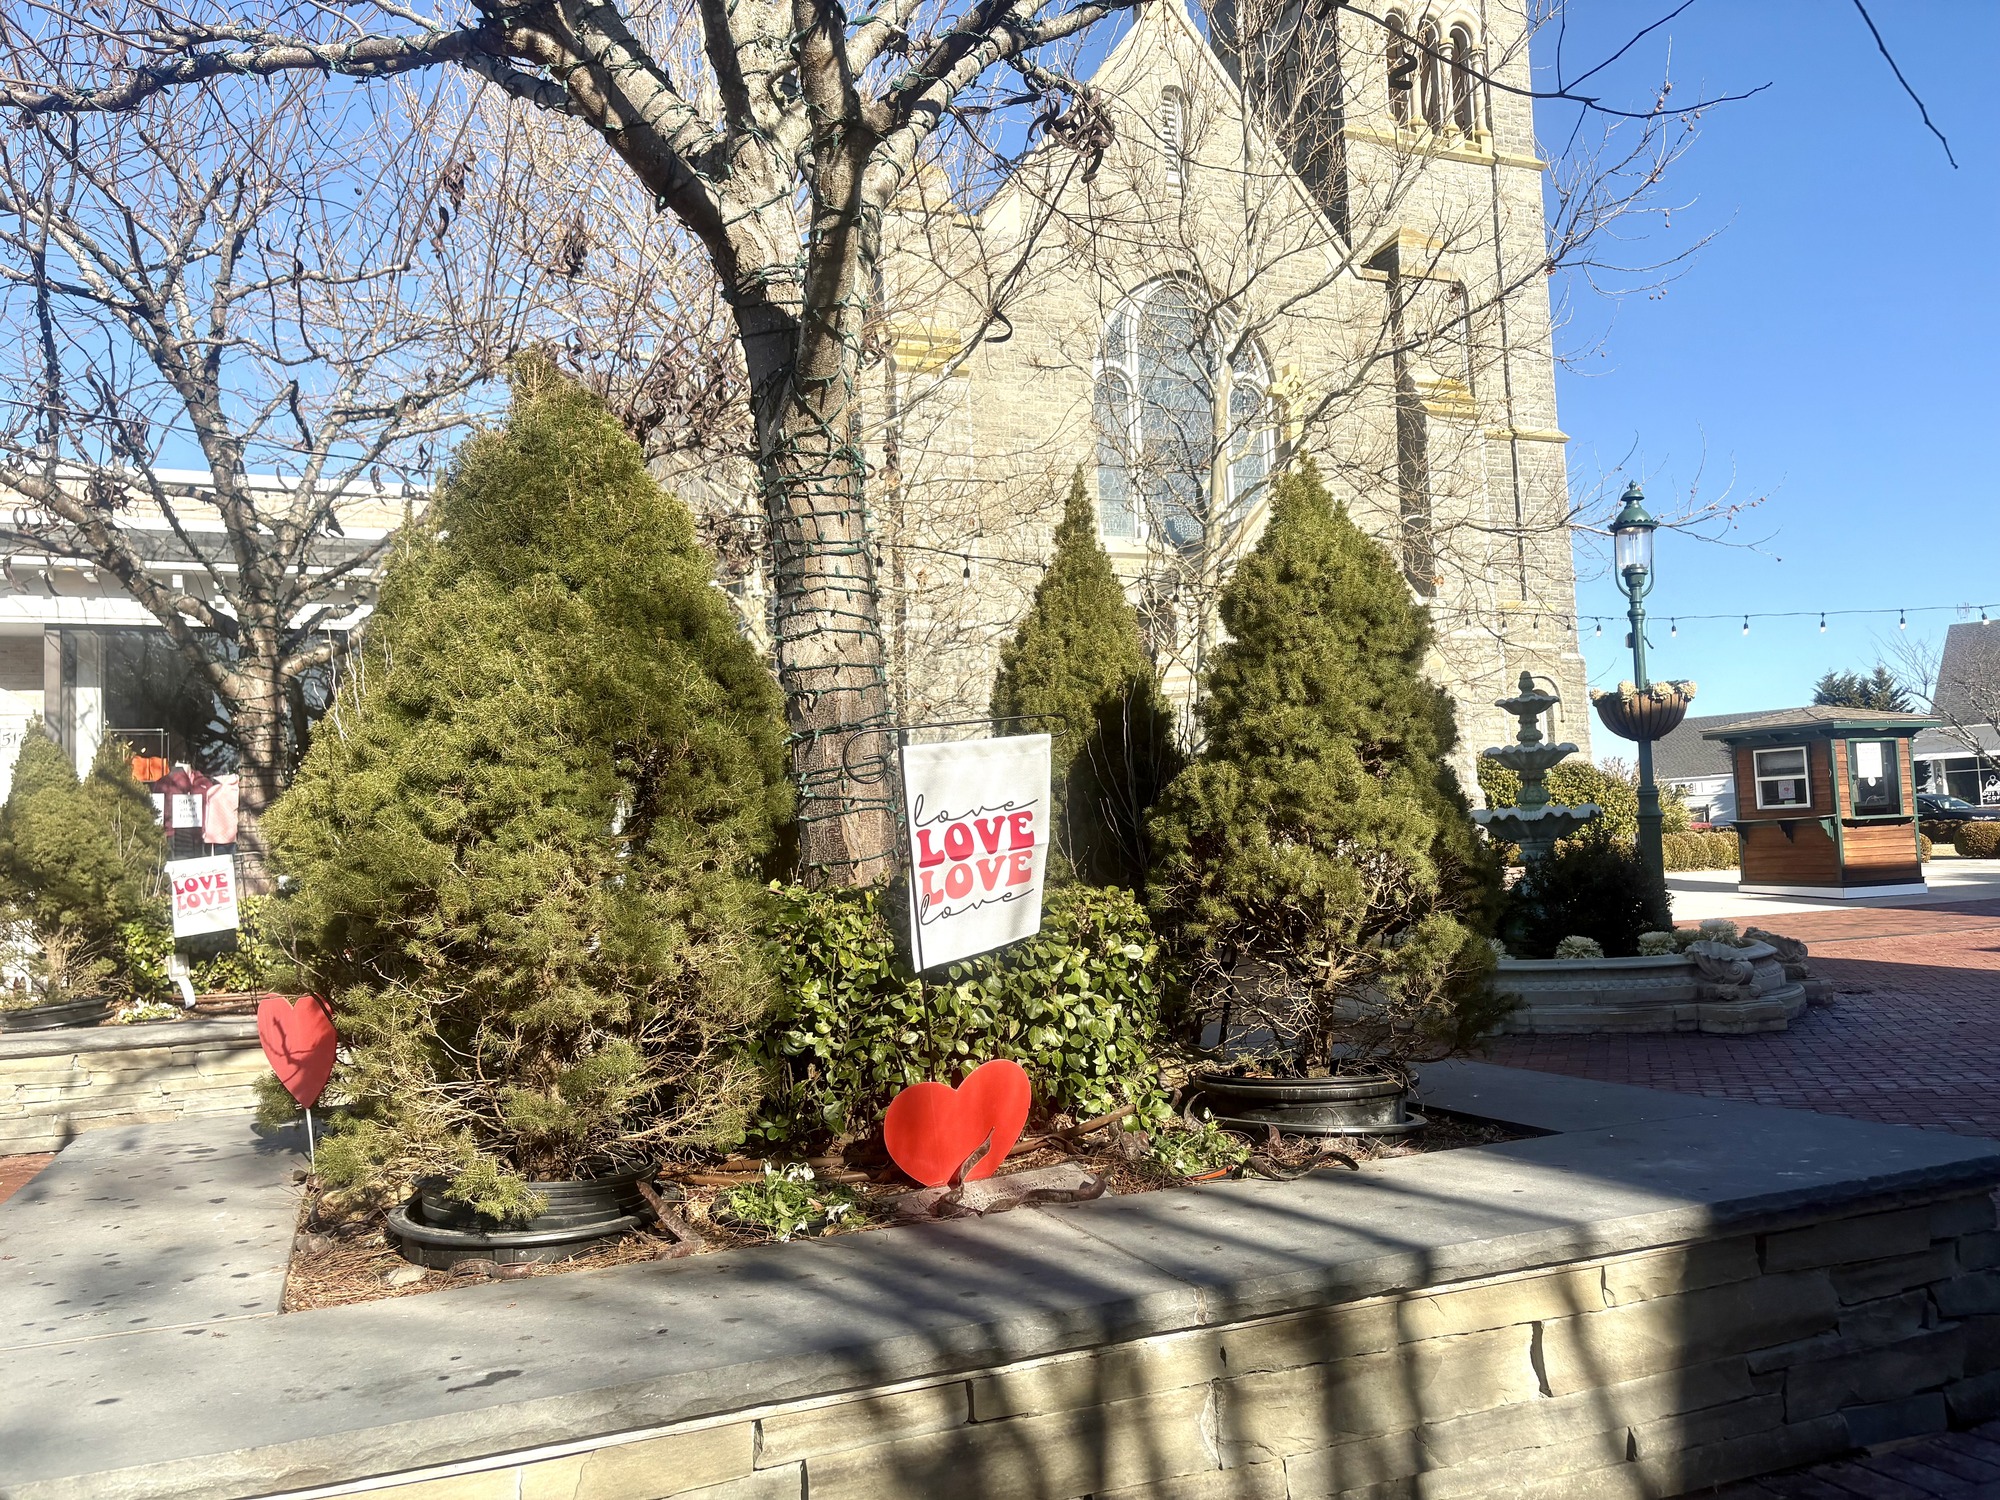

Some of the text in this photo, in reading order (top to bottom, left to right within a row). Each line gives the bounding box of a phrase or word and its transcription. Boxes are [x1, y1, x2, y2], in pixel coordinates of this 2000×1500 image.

[914, 794, 1039, 828] love
[916, 810, 1035, 868] LOVE
[173, 873, 228, 895] LOVE
[919, 850, 1033, 907] LOVE
[176, 888, 231, 911] LOVE
[920, 893, 1035, 926] love
